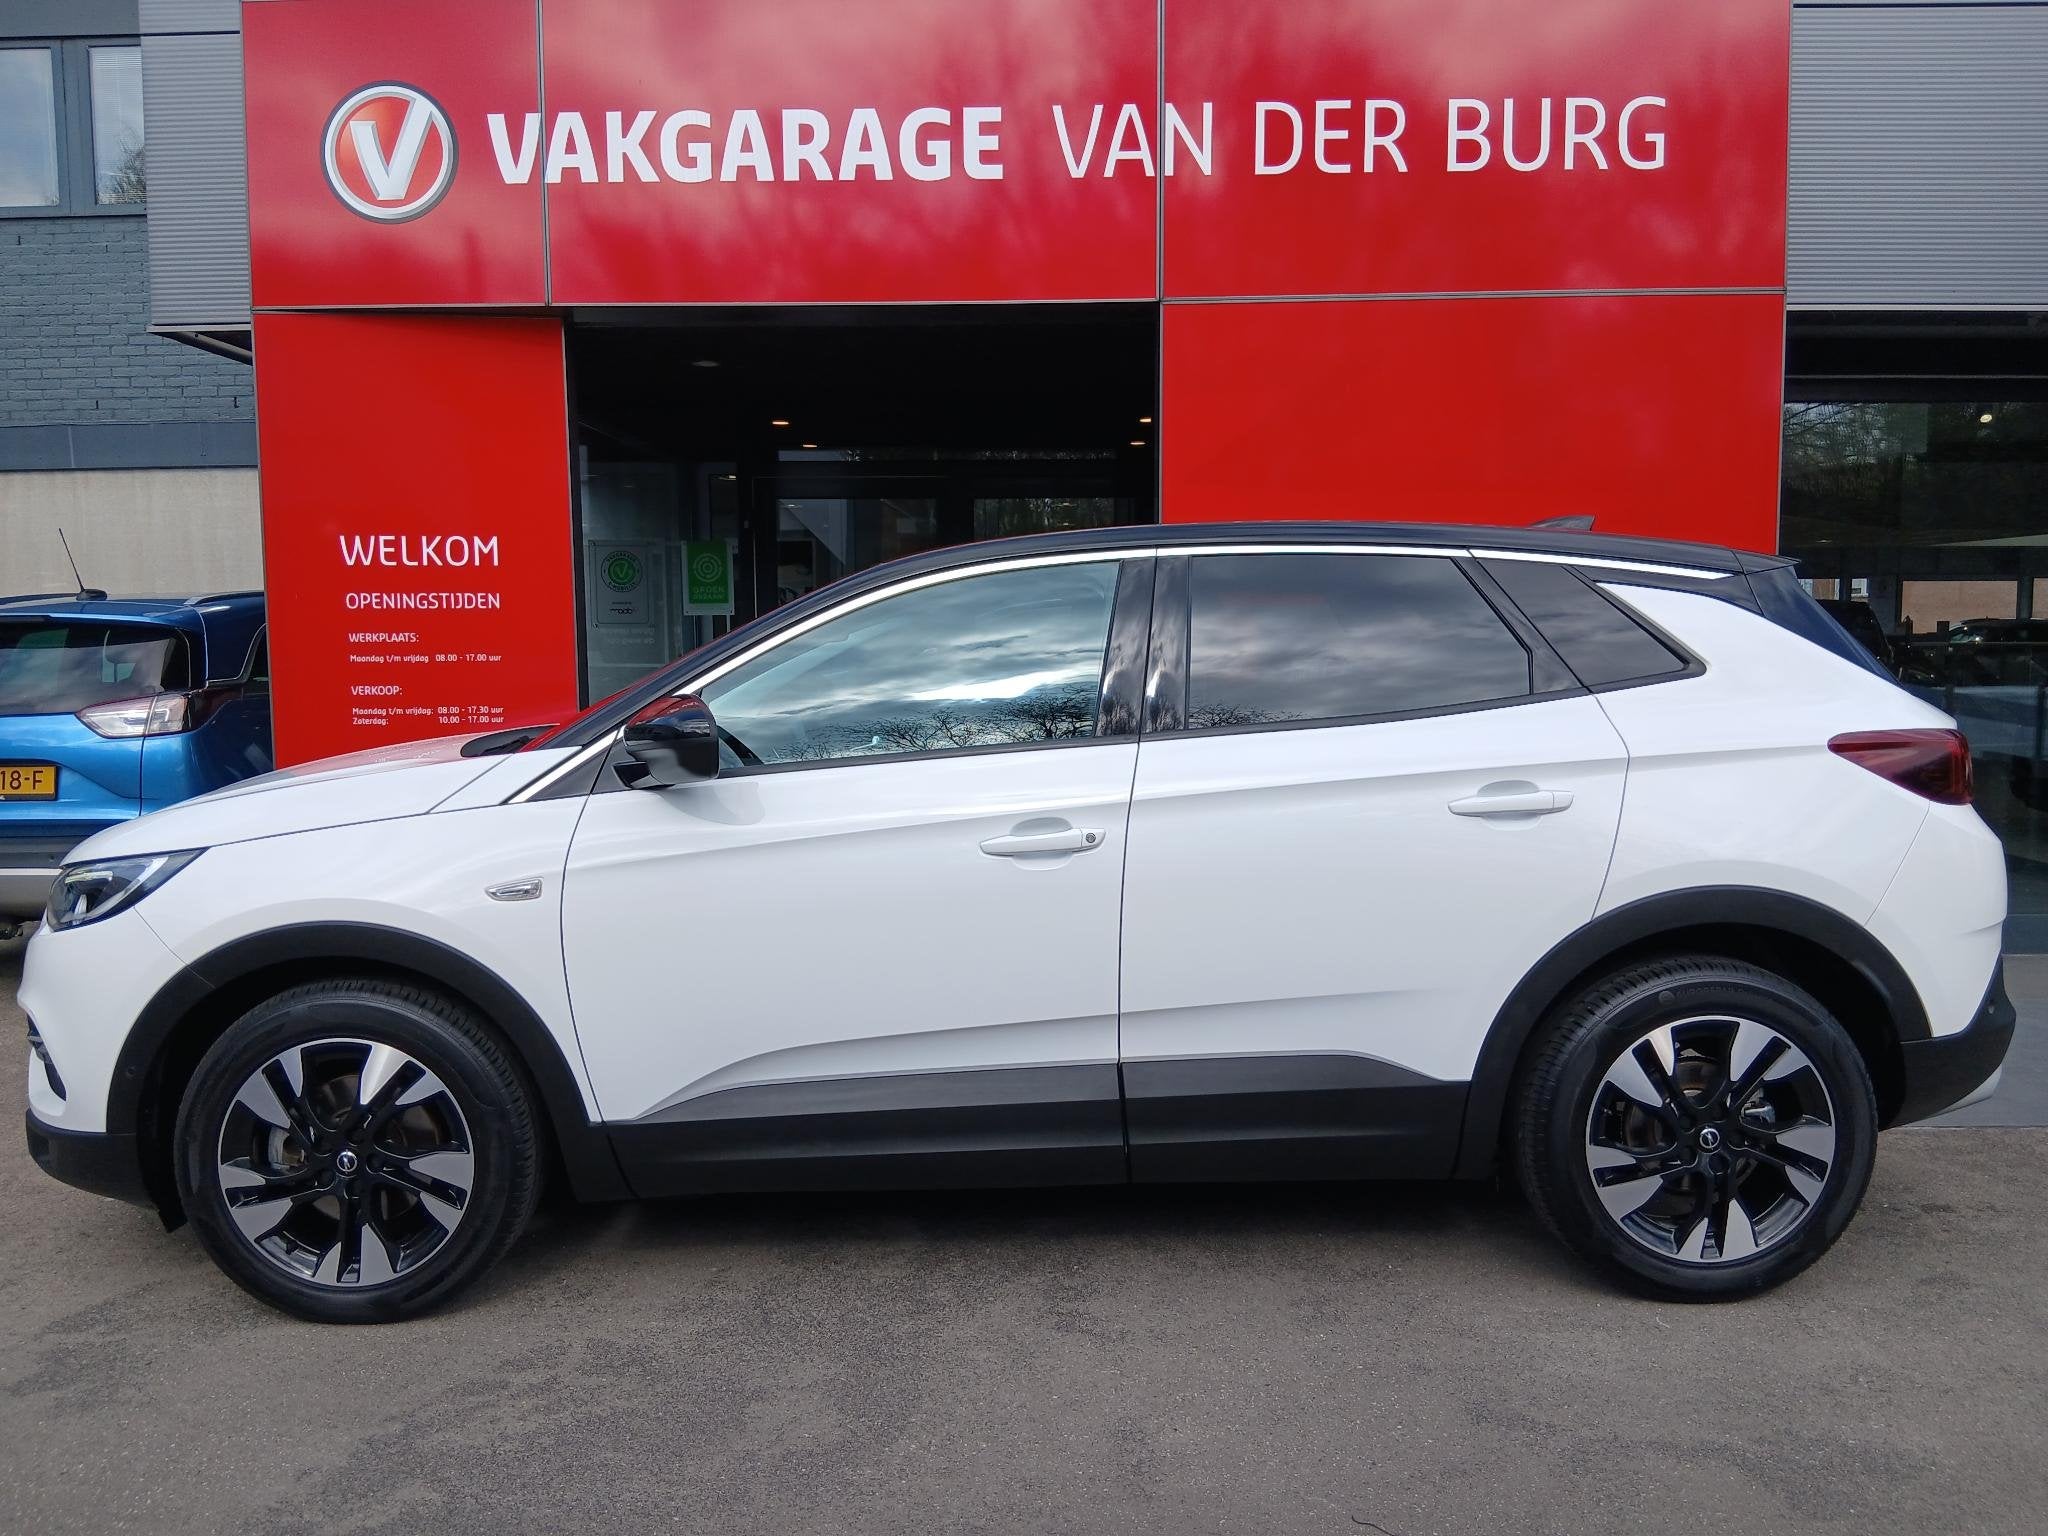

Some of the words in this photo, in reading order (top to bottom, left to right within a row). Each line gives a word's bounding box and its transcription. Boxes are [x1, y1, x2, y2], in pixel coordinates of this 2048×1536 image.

[486, 106, 1004, 184] VAKGARAGE
[1052, 101, 1213, 179] VAN
[1254, 99, 1408, 175] DER
[1446, 96, 1667, 173] BURG
[339, 535, 499, 567] WELKOM
[345, 592, 500, 610] OPENINGSTIJDEN
[348, 632, 420, 643] WERKPLAATS:
[350, 654, 384, 664] Maandag
[386, 654, 402, 663] t/m
[403, 654, 429, 664] vrijdag
[435, 653, 458, 662] 08.00
[465, 653, 488, 662] 17.00
[351, 685, 403, 696] VERKOOP:
[352, 707, 387, 716] Maandag
[388, 706, 404, 715] t/m
[405, 706, 434, 716] vrijdag:
[437, 706, 460, 714] 08.00
[467, 705, 489, 714] 17.30
[352, 717, 389, 726] Zaterdag:
[438, 715, 460, 724] 10.00
[468, 715, 490, 724] 17.00
[0, 770, 44, 790] 18-F
